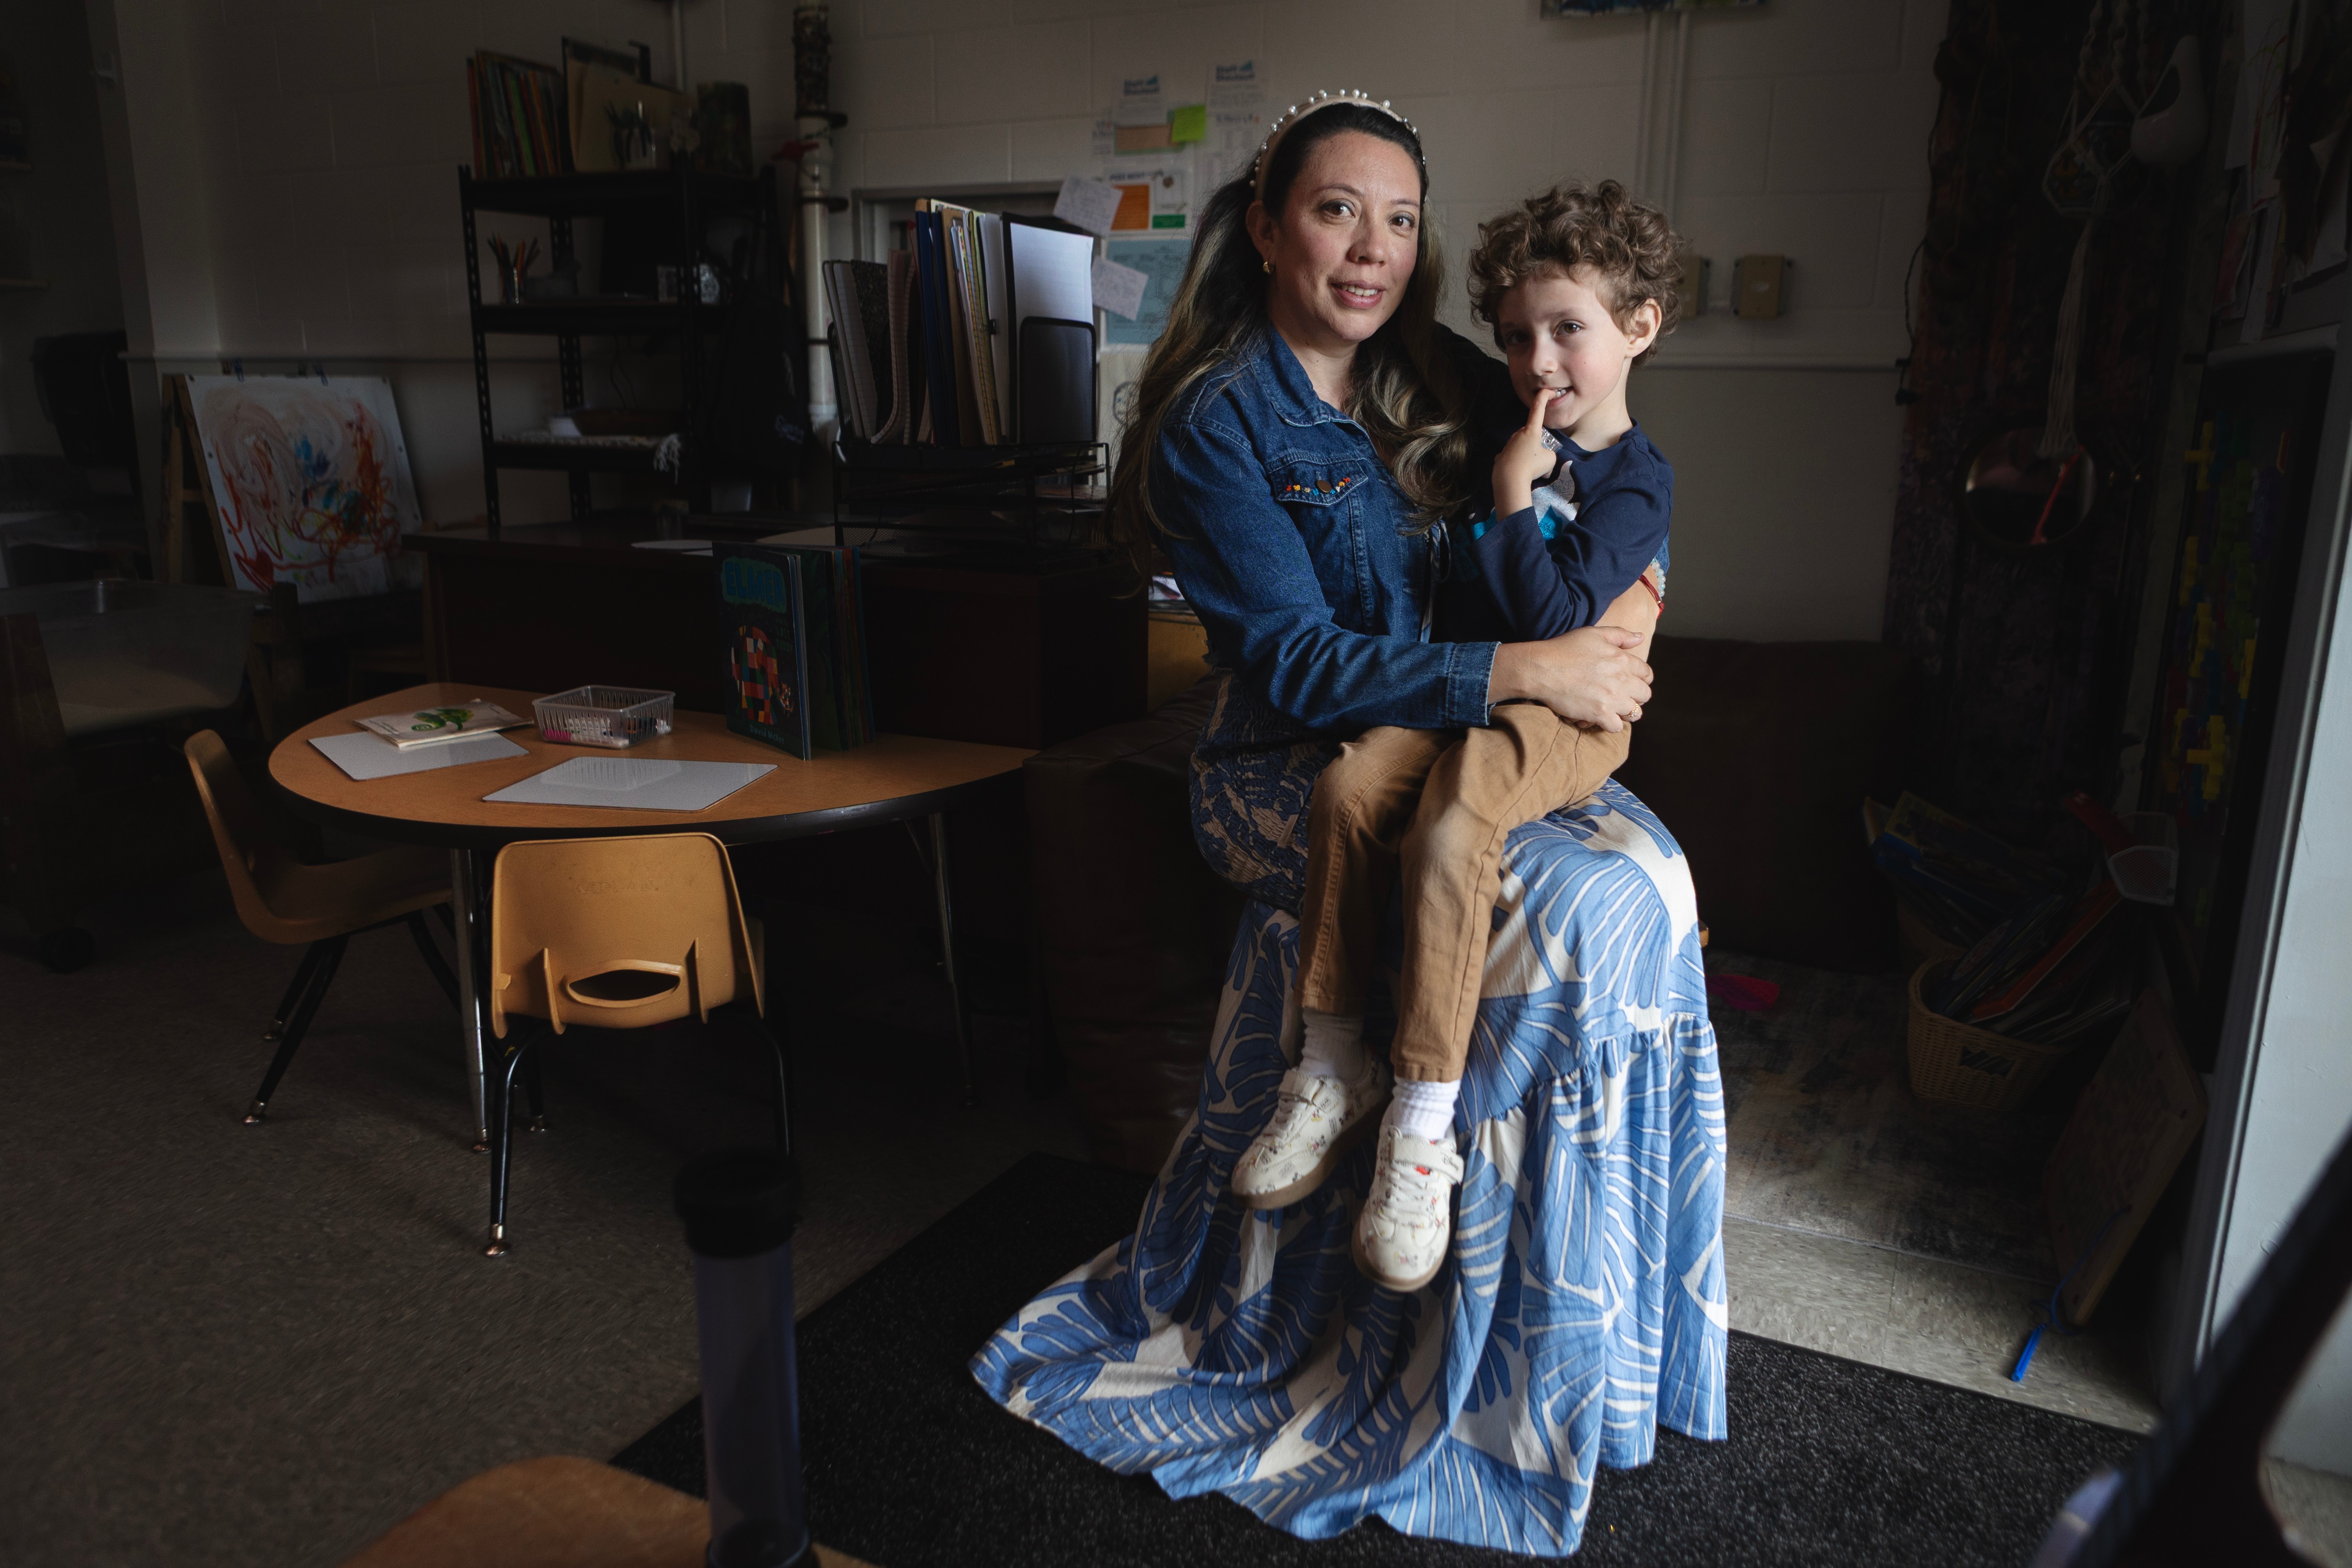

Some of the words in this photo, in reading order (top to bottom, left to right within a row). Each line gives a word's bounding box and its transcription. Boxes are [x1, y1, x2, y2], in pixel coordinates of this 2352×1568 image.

[725, 561, 785, 608] ELMER
[776, 626, 790, 640] LOST
[776, 639, 793, 653] TEDDY
[750, 724, 766, 737] David
